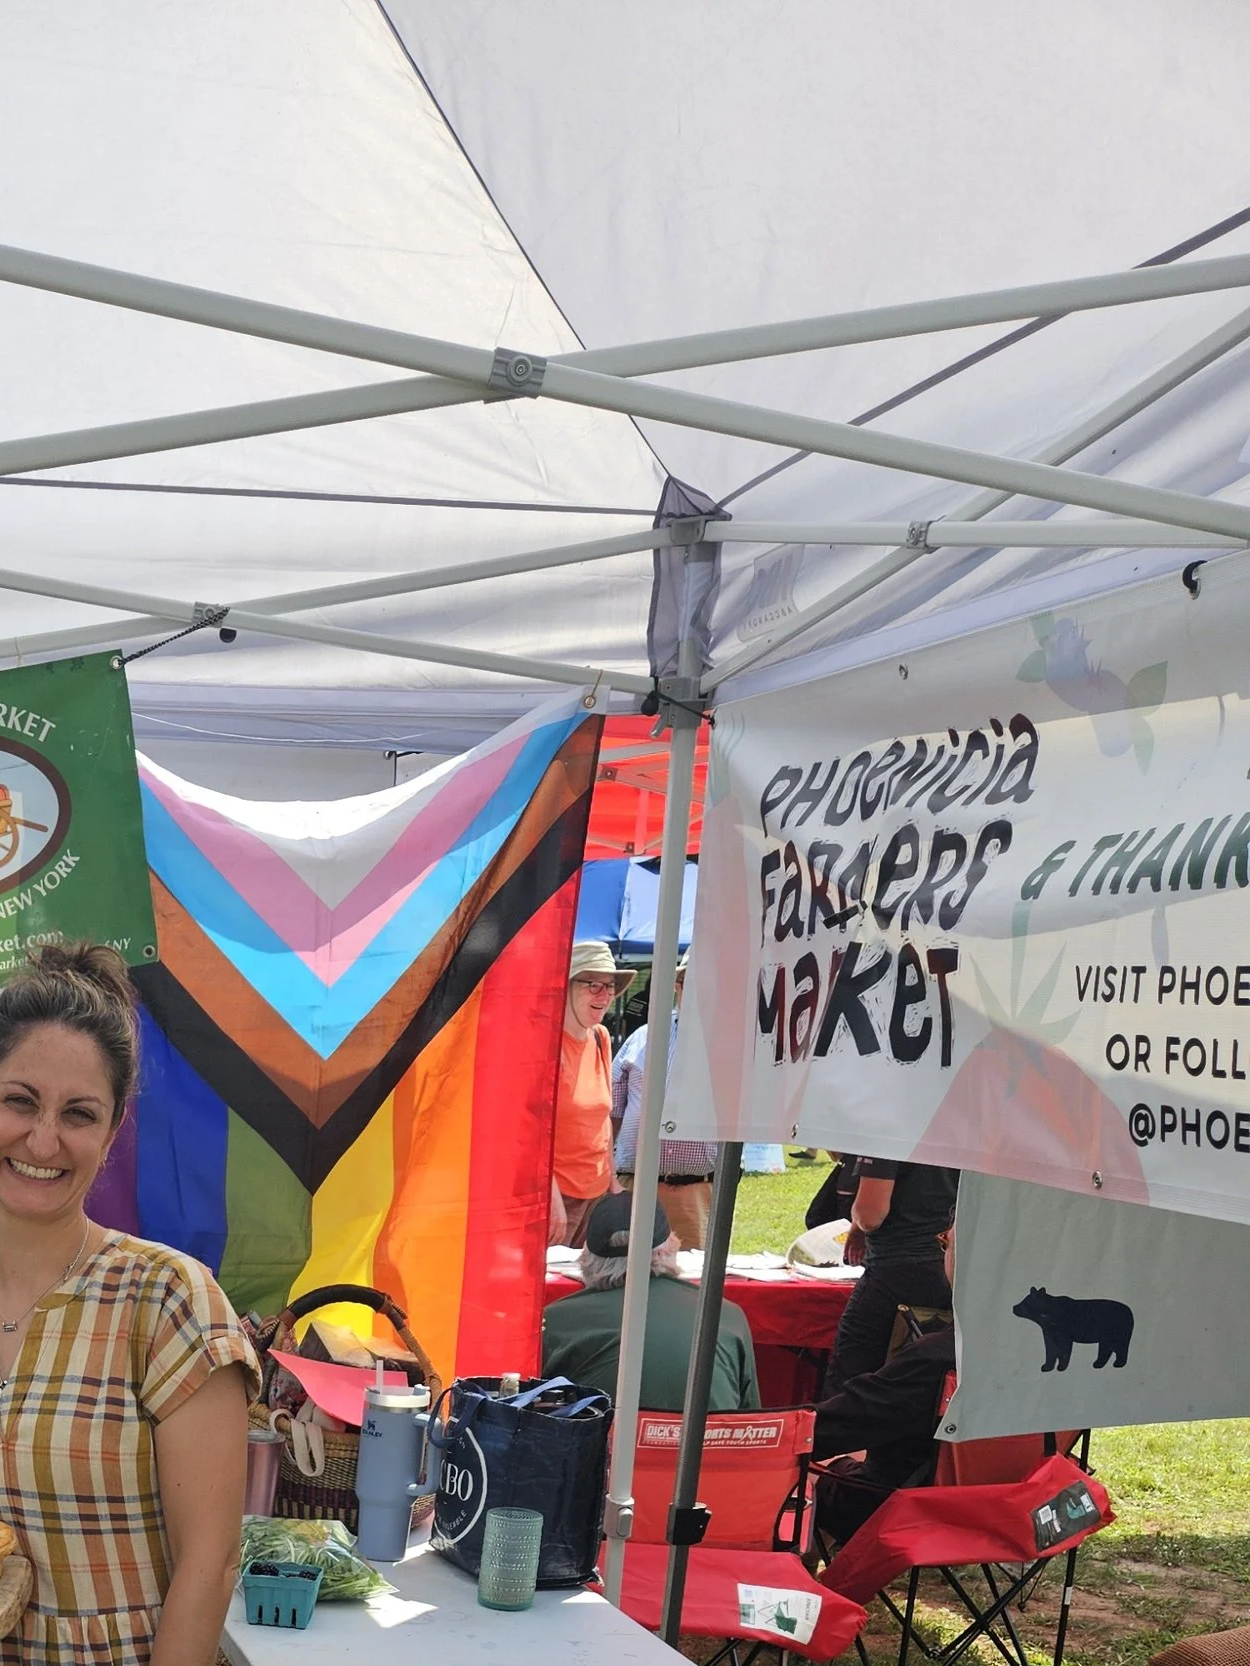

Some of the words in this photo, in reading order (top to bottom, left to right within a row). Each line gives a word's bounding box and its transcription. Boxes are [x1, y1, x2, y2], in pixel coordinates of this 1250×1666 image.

[34, 850, 80, 896] YORK
[1021, 840, 1077, 900] &
[1076, 966, 1146, 1003] VISIT
[1106, 1034, 1151, 1073] OR
[647, 1425, 681, 1436] DICK'S
